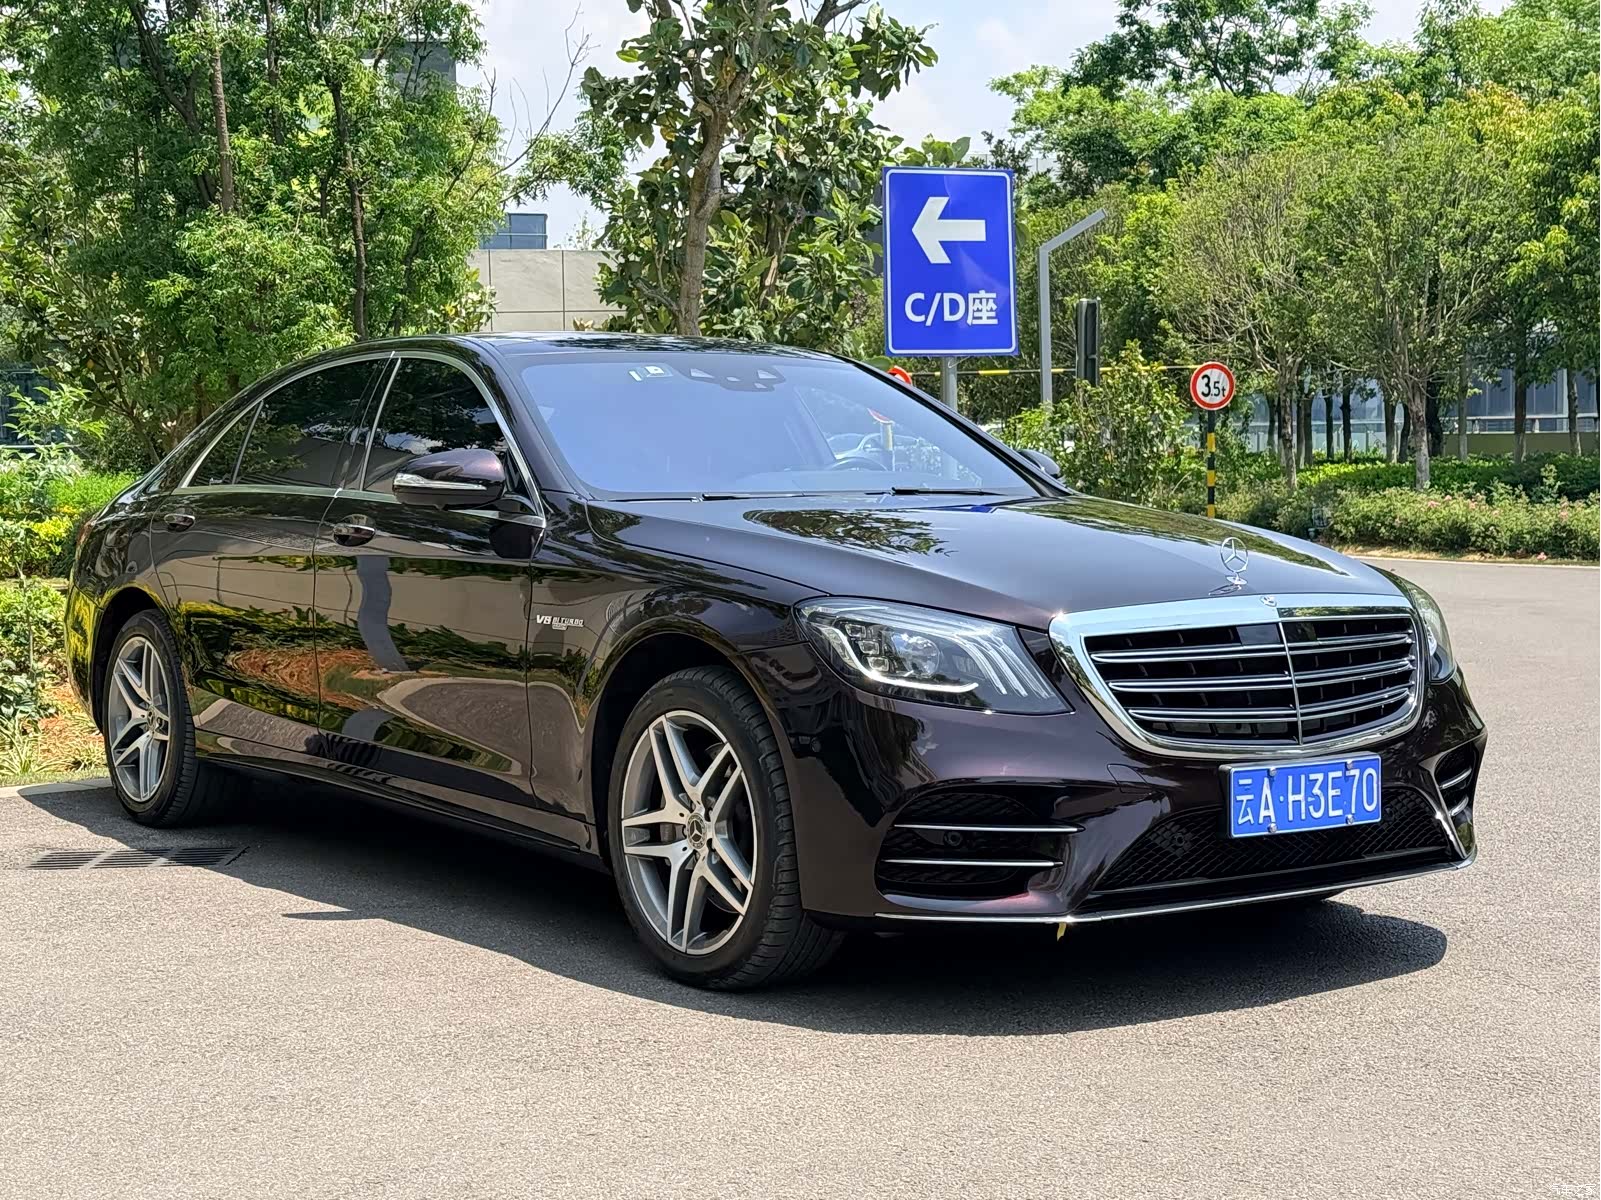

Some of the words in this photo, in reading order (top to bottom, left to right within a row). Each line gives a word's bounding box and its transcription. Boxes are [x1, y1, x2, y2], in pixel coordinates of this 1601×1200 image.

[904, 289, 999, 327] C/D座
[1201, 374, 1226, 397] 3.5t
[536, 614, 552, 625] V8
